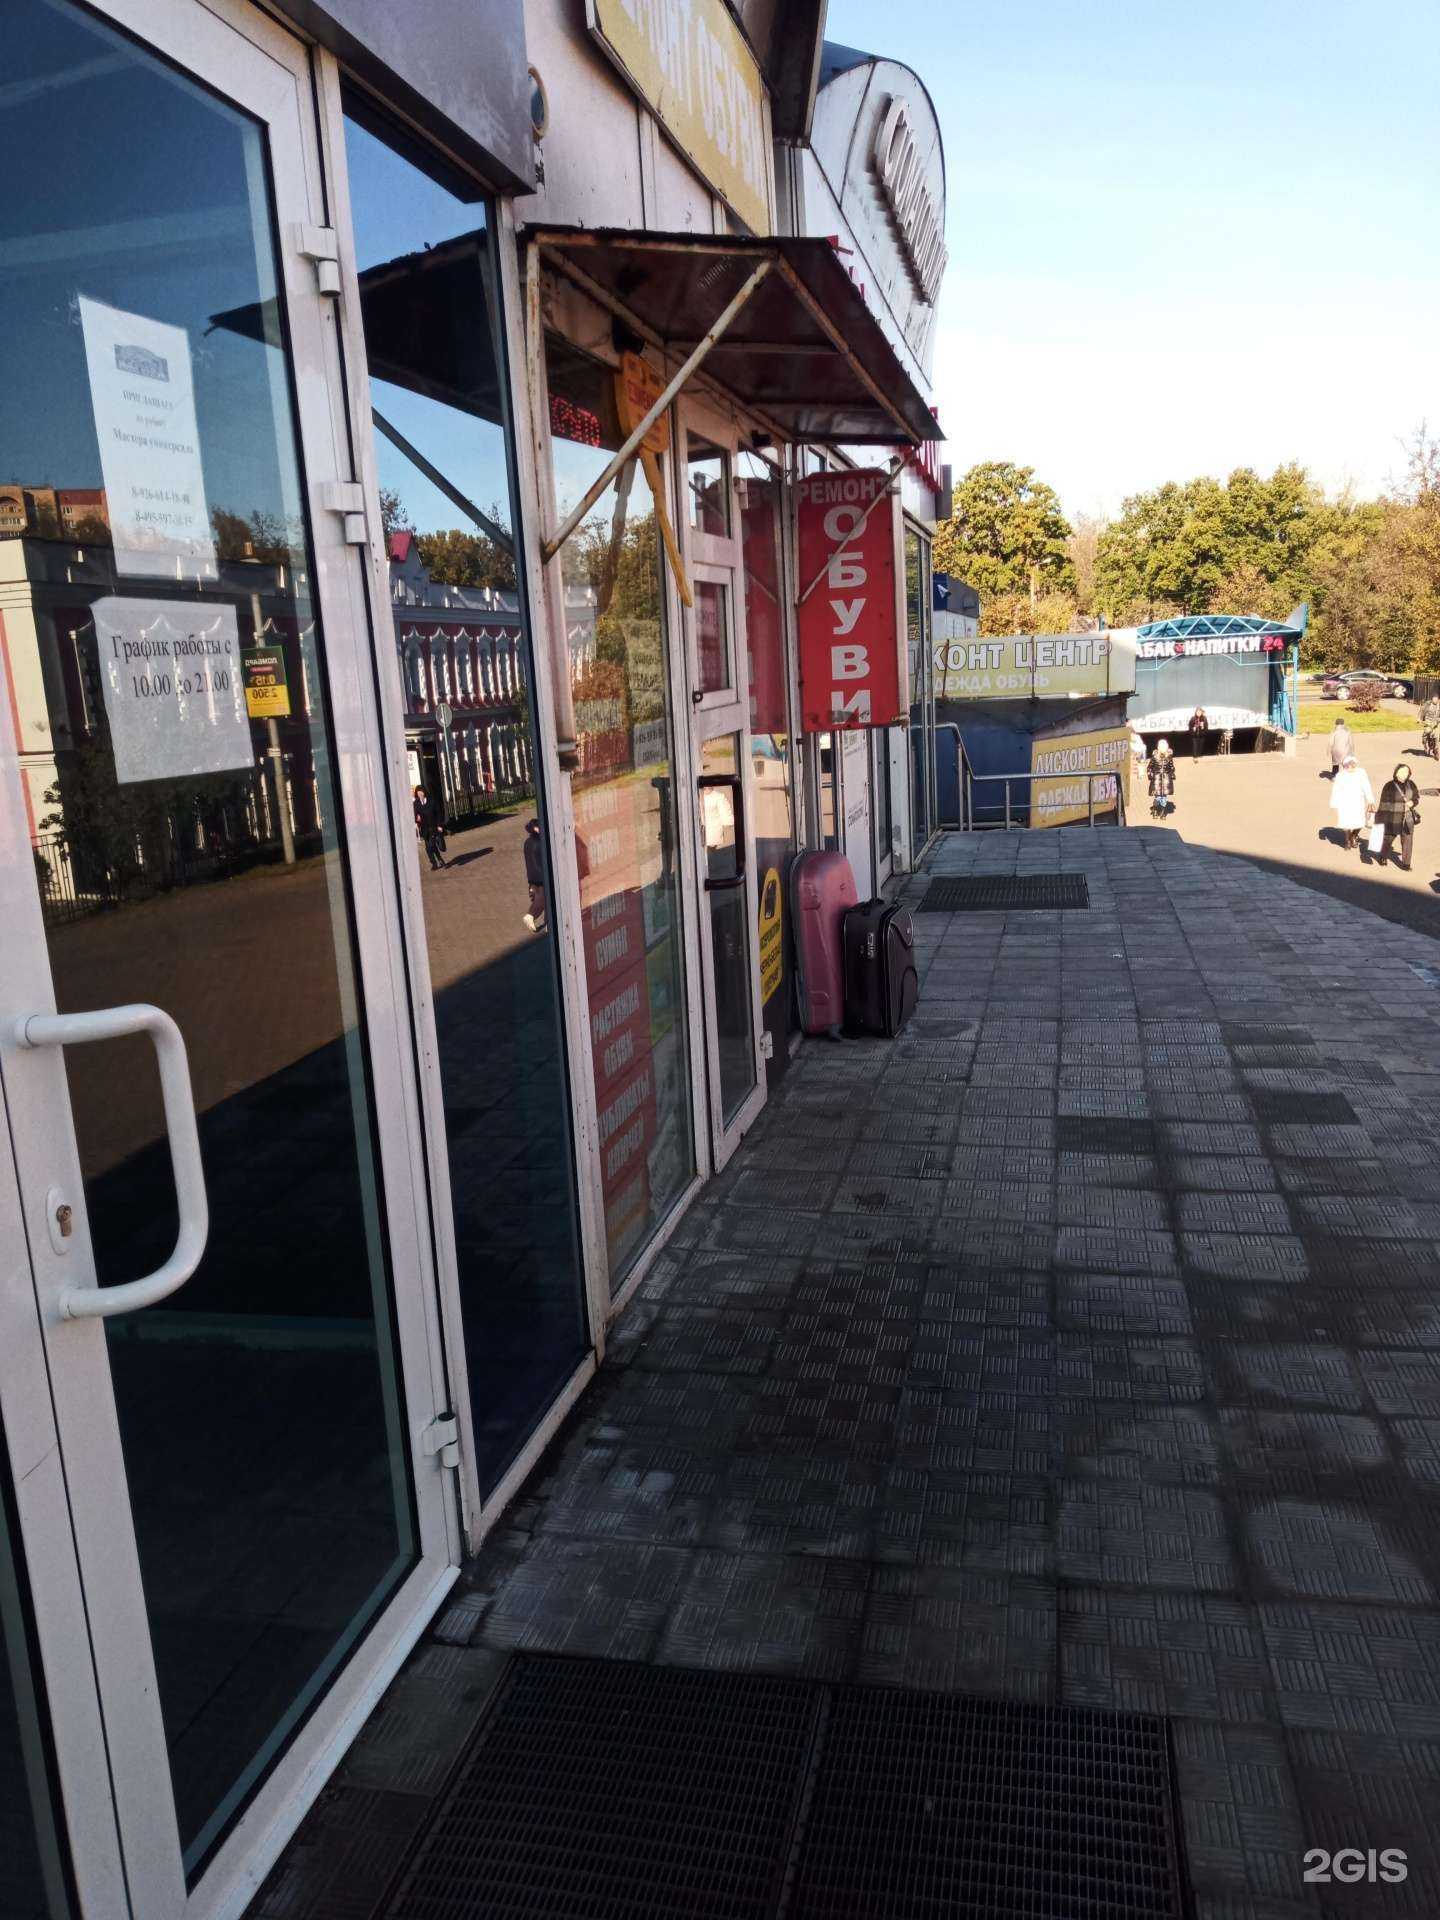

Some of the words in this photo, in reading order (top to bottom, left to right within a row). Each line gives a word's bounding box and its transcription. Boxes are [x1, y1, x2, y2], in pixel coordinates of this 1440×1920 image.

[796, 476, 891, 504] РЕМОНТ
[823, 505, 872, 725] ОБУВИ
[112, 635, 170, 664] График
[173, 634, 222, 660] работы
[224, 639, 232, 654] с
[934, 642, 1004, 671] КОНТ
[1014, 638, 1112, 673] ЦЕНТР
[1136, 641, 1175, 658] АБАК
[1184, 636, 1260, 656] НАПИТКИ
[1262, 635, 1285, 651] 24
[132, 674, 171, 698] 10.00
[195, 671, 229, 693] 21.00
[934, 675, 992, 692] ДЕЖДА
[1095, 739, 1129, 768] ЦЕНТР
